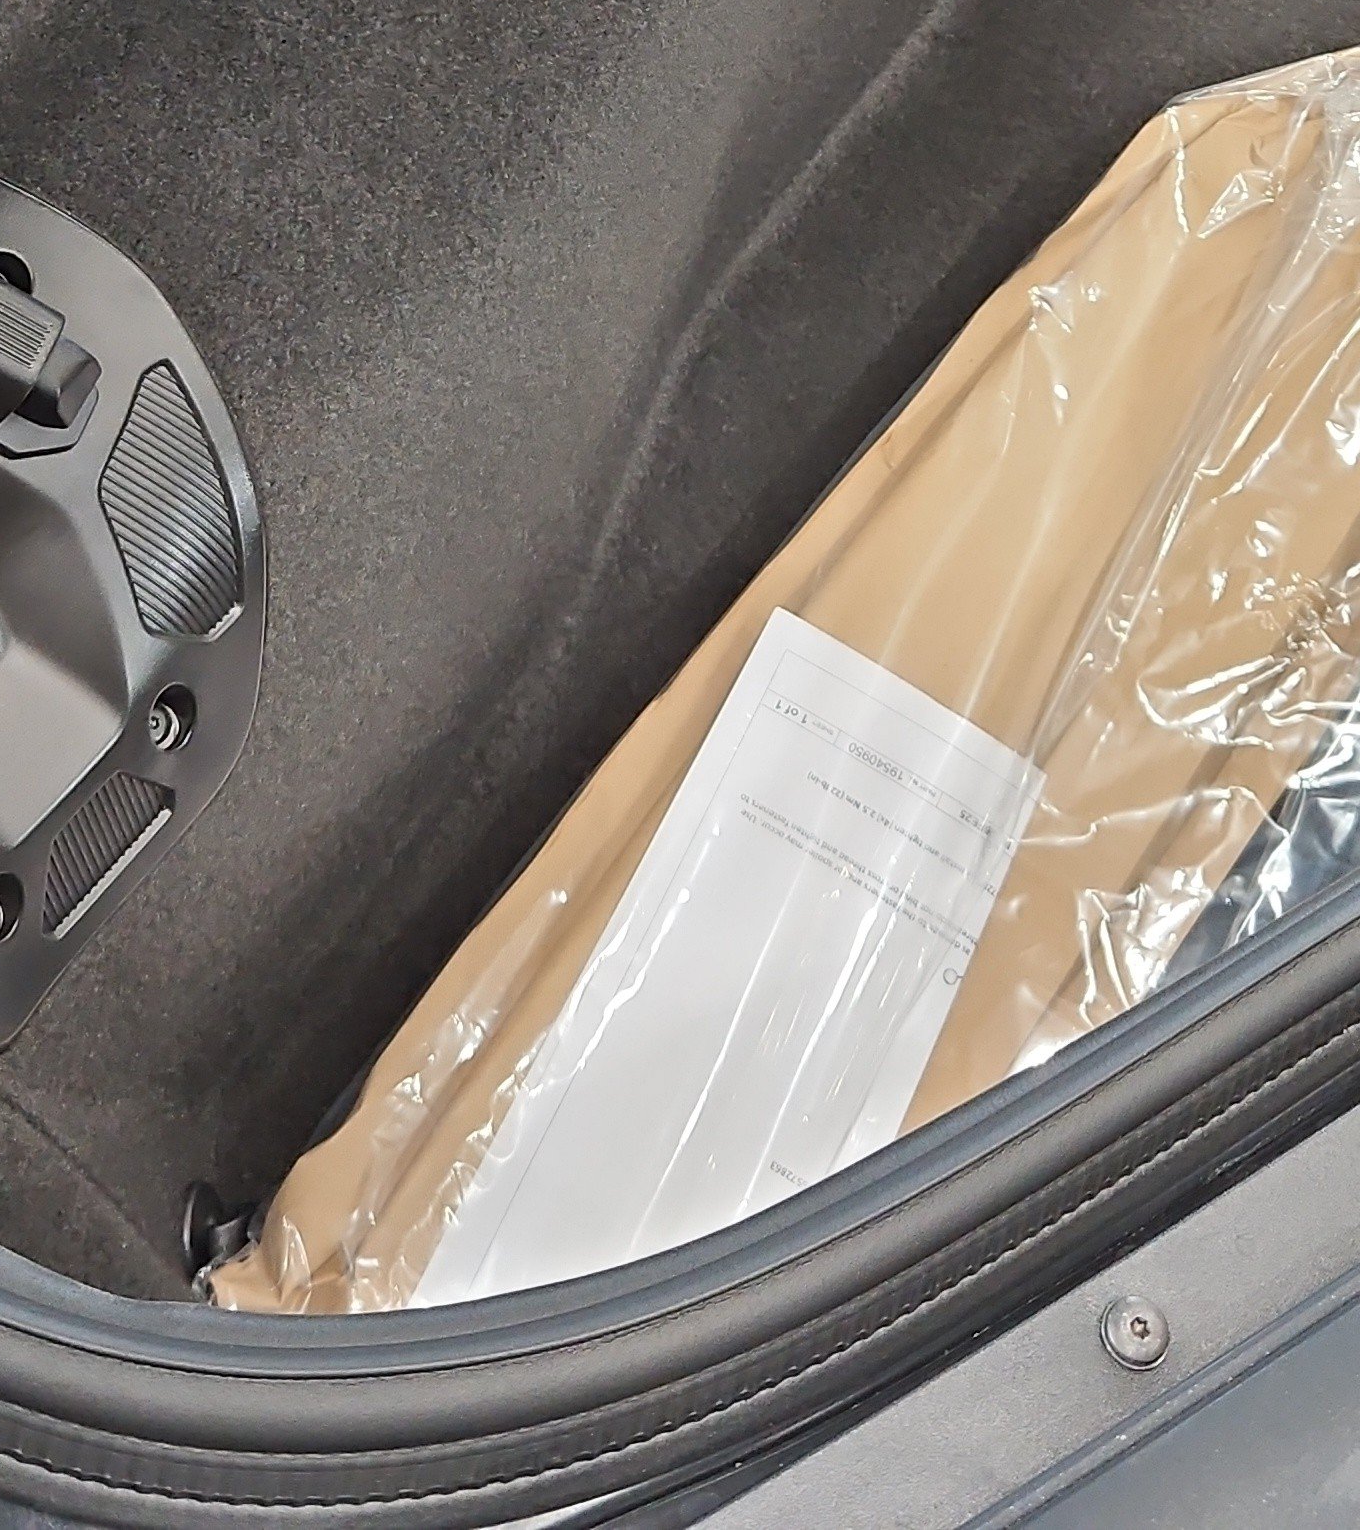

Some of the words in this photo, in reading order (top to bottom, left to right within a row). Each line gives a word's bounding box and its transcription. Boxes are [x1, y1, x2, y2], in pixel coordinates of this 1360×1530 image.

[774, 698, 783, 710] 1
[783, 703, 800, 718] of
[800, 712, 809, 724] 1
[846, 739, 906, 781] 19540950
[738, 791, 754, 806] to
[828, 783, 846, 801] (22
[843, 794, 861, 809] Nm
[738, 807, 757, 823] Use
[753, 799, 791, 828] fasteners
[860, 804, 876, 818] 2.5
[784, 831, 806, 850] may
[819, 839, 838, 856] and
